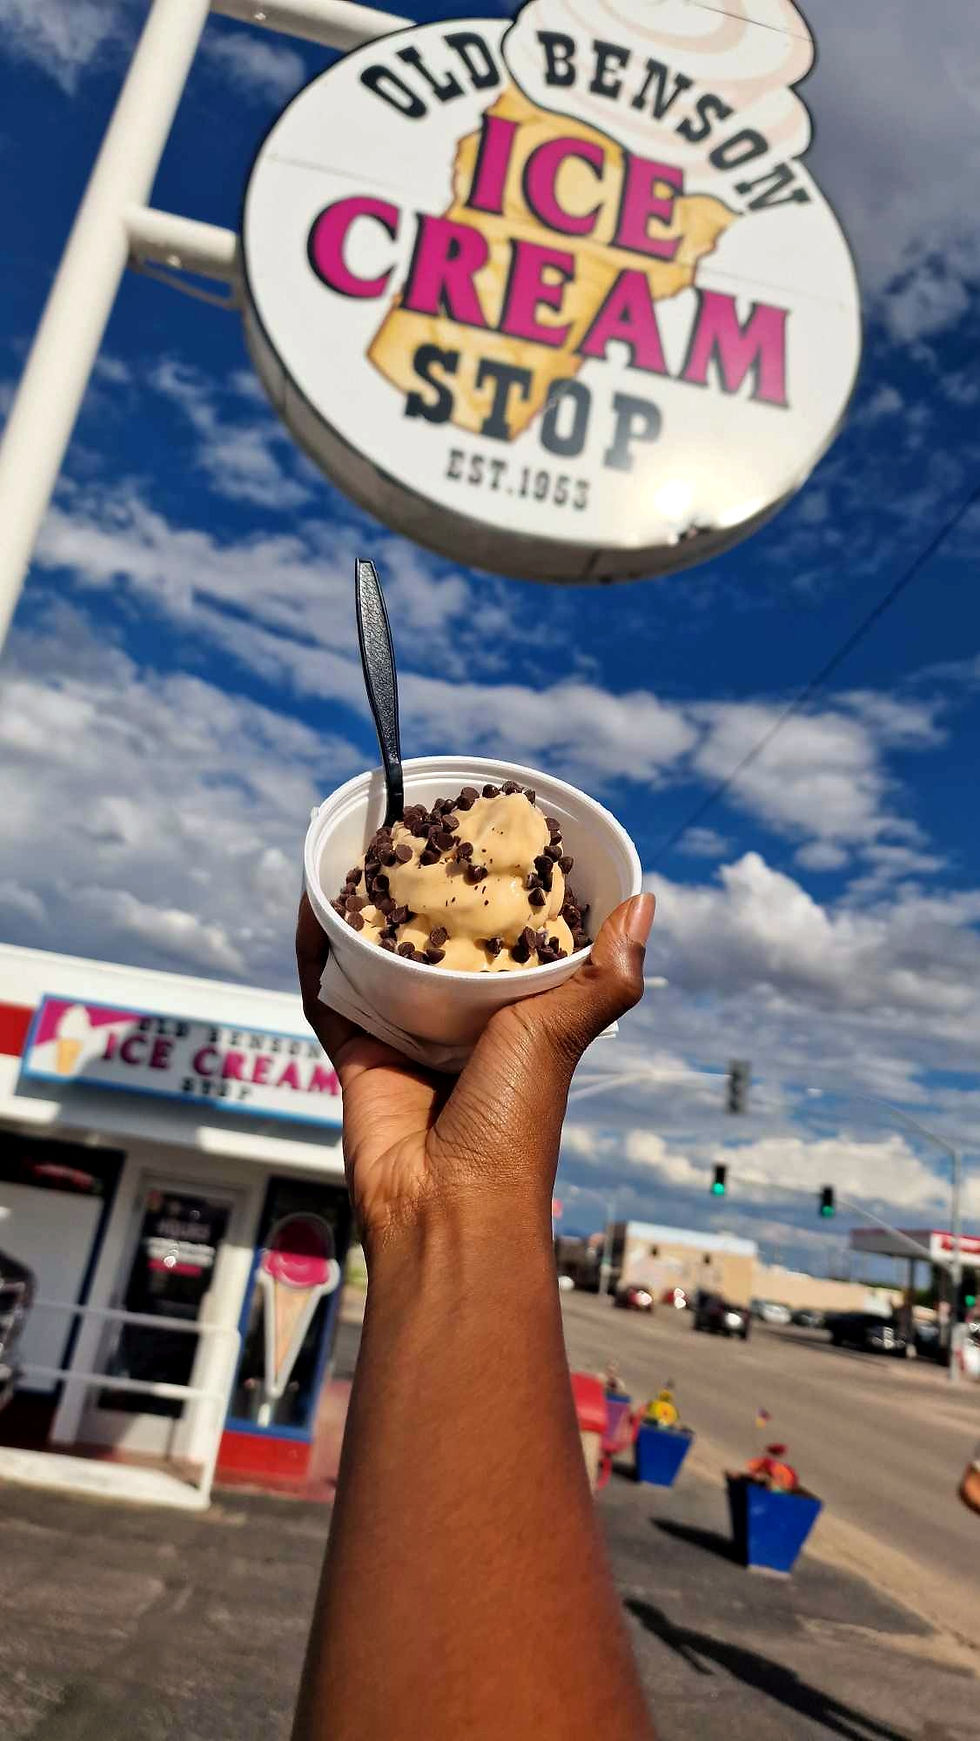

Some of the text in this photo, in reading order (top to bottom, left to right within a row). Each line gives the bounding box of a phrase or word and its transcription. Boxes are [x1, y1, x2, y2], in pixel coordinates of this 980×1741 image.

[360, 30, 811, 213] OLD BENSON
[465, 113, 685, 262] ICE
[307, 195, 791, 410] CREAM
[403, 343, 663, 472] STOP
[102, 1032, 340, 1096] ICE CREAM
